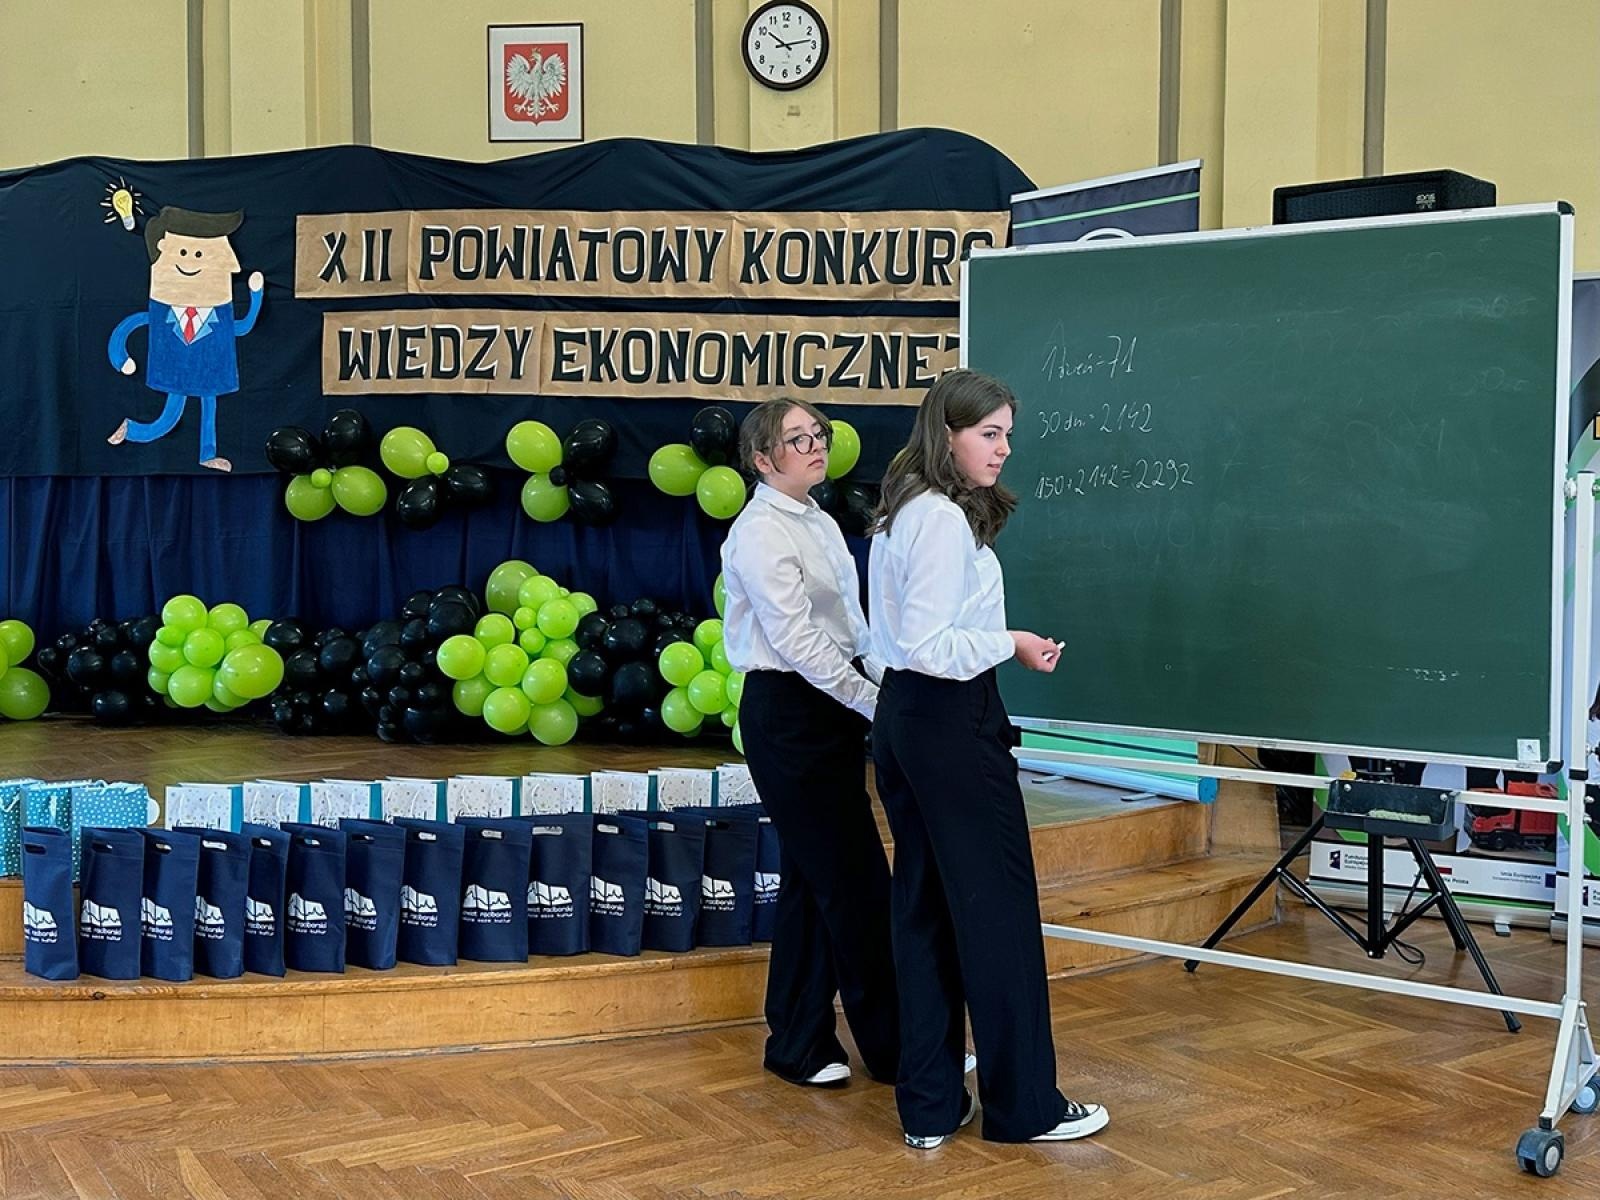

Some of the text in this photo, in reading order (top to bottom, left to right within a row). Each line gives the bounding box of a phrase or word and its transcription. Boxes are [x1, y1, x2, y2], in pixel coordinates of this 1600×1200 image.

[769, 16, 777, 25] 11
[782, 12, 791, 21] 12
[798, 16, 802, 25] 1
[758, 27, 768, 36] 10
[806, 27, 813, 36] 2
[754, 41, 761, 50] 9
[811, 41, 817, 50] 3
[759, 55, 765, 65] 8
[805, 55, 812, 64] 4
[769, 66, 775, 75] 7
[782, 69, 788, 78] 6
[796, 66, 802, 75] 5
[418, 224, 727, 286] POWIATOWY
[337, 324, 534, 381] WIEDZY
